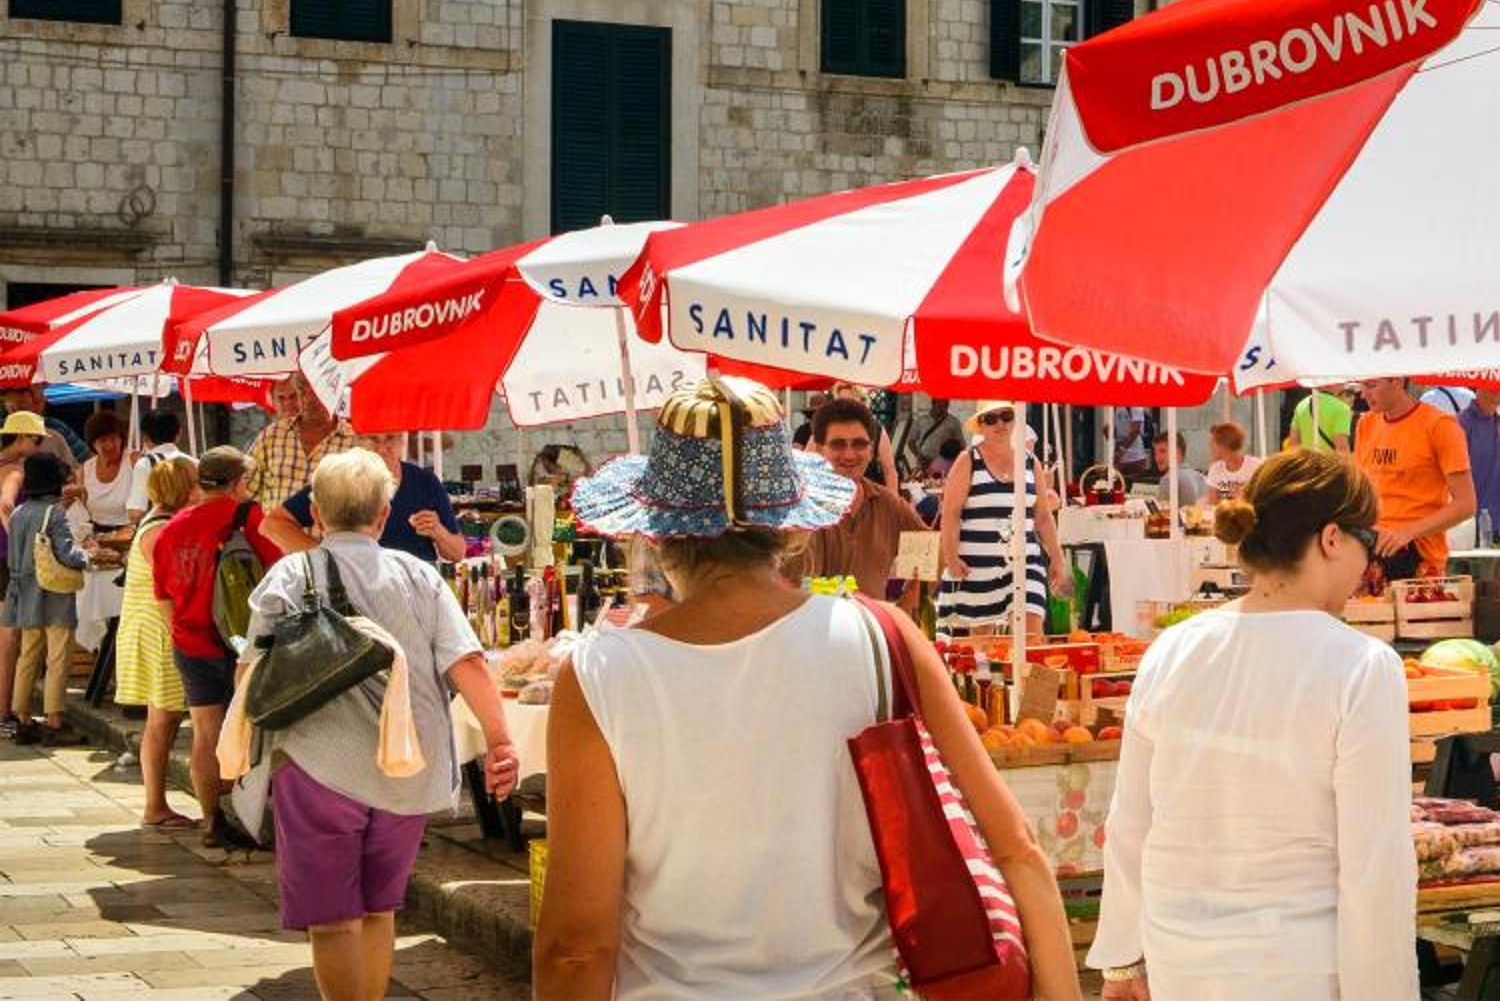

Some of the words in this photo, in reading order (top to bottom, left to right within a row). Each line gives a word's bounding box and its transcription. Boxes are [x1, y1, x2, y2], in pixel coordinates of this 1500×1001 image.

[351, 288, 485, 342] DUBROVNIK
[689, 303, 877, 366] SANITAT
[59, 350, 157, 376] SANITAT
[951, 345, 1184, 387] DUBROVNIK
